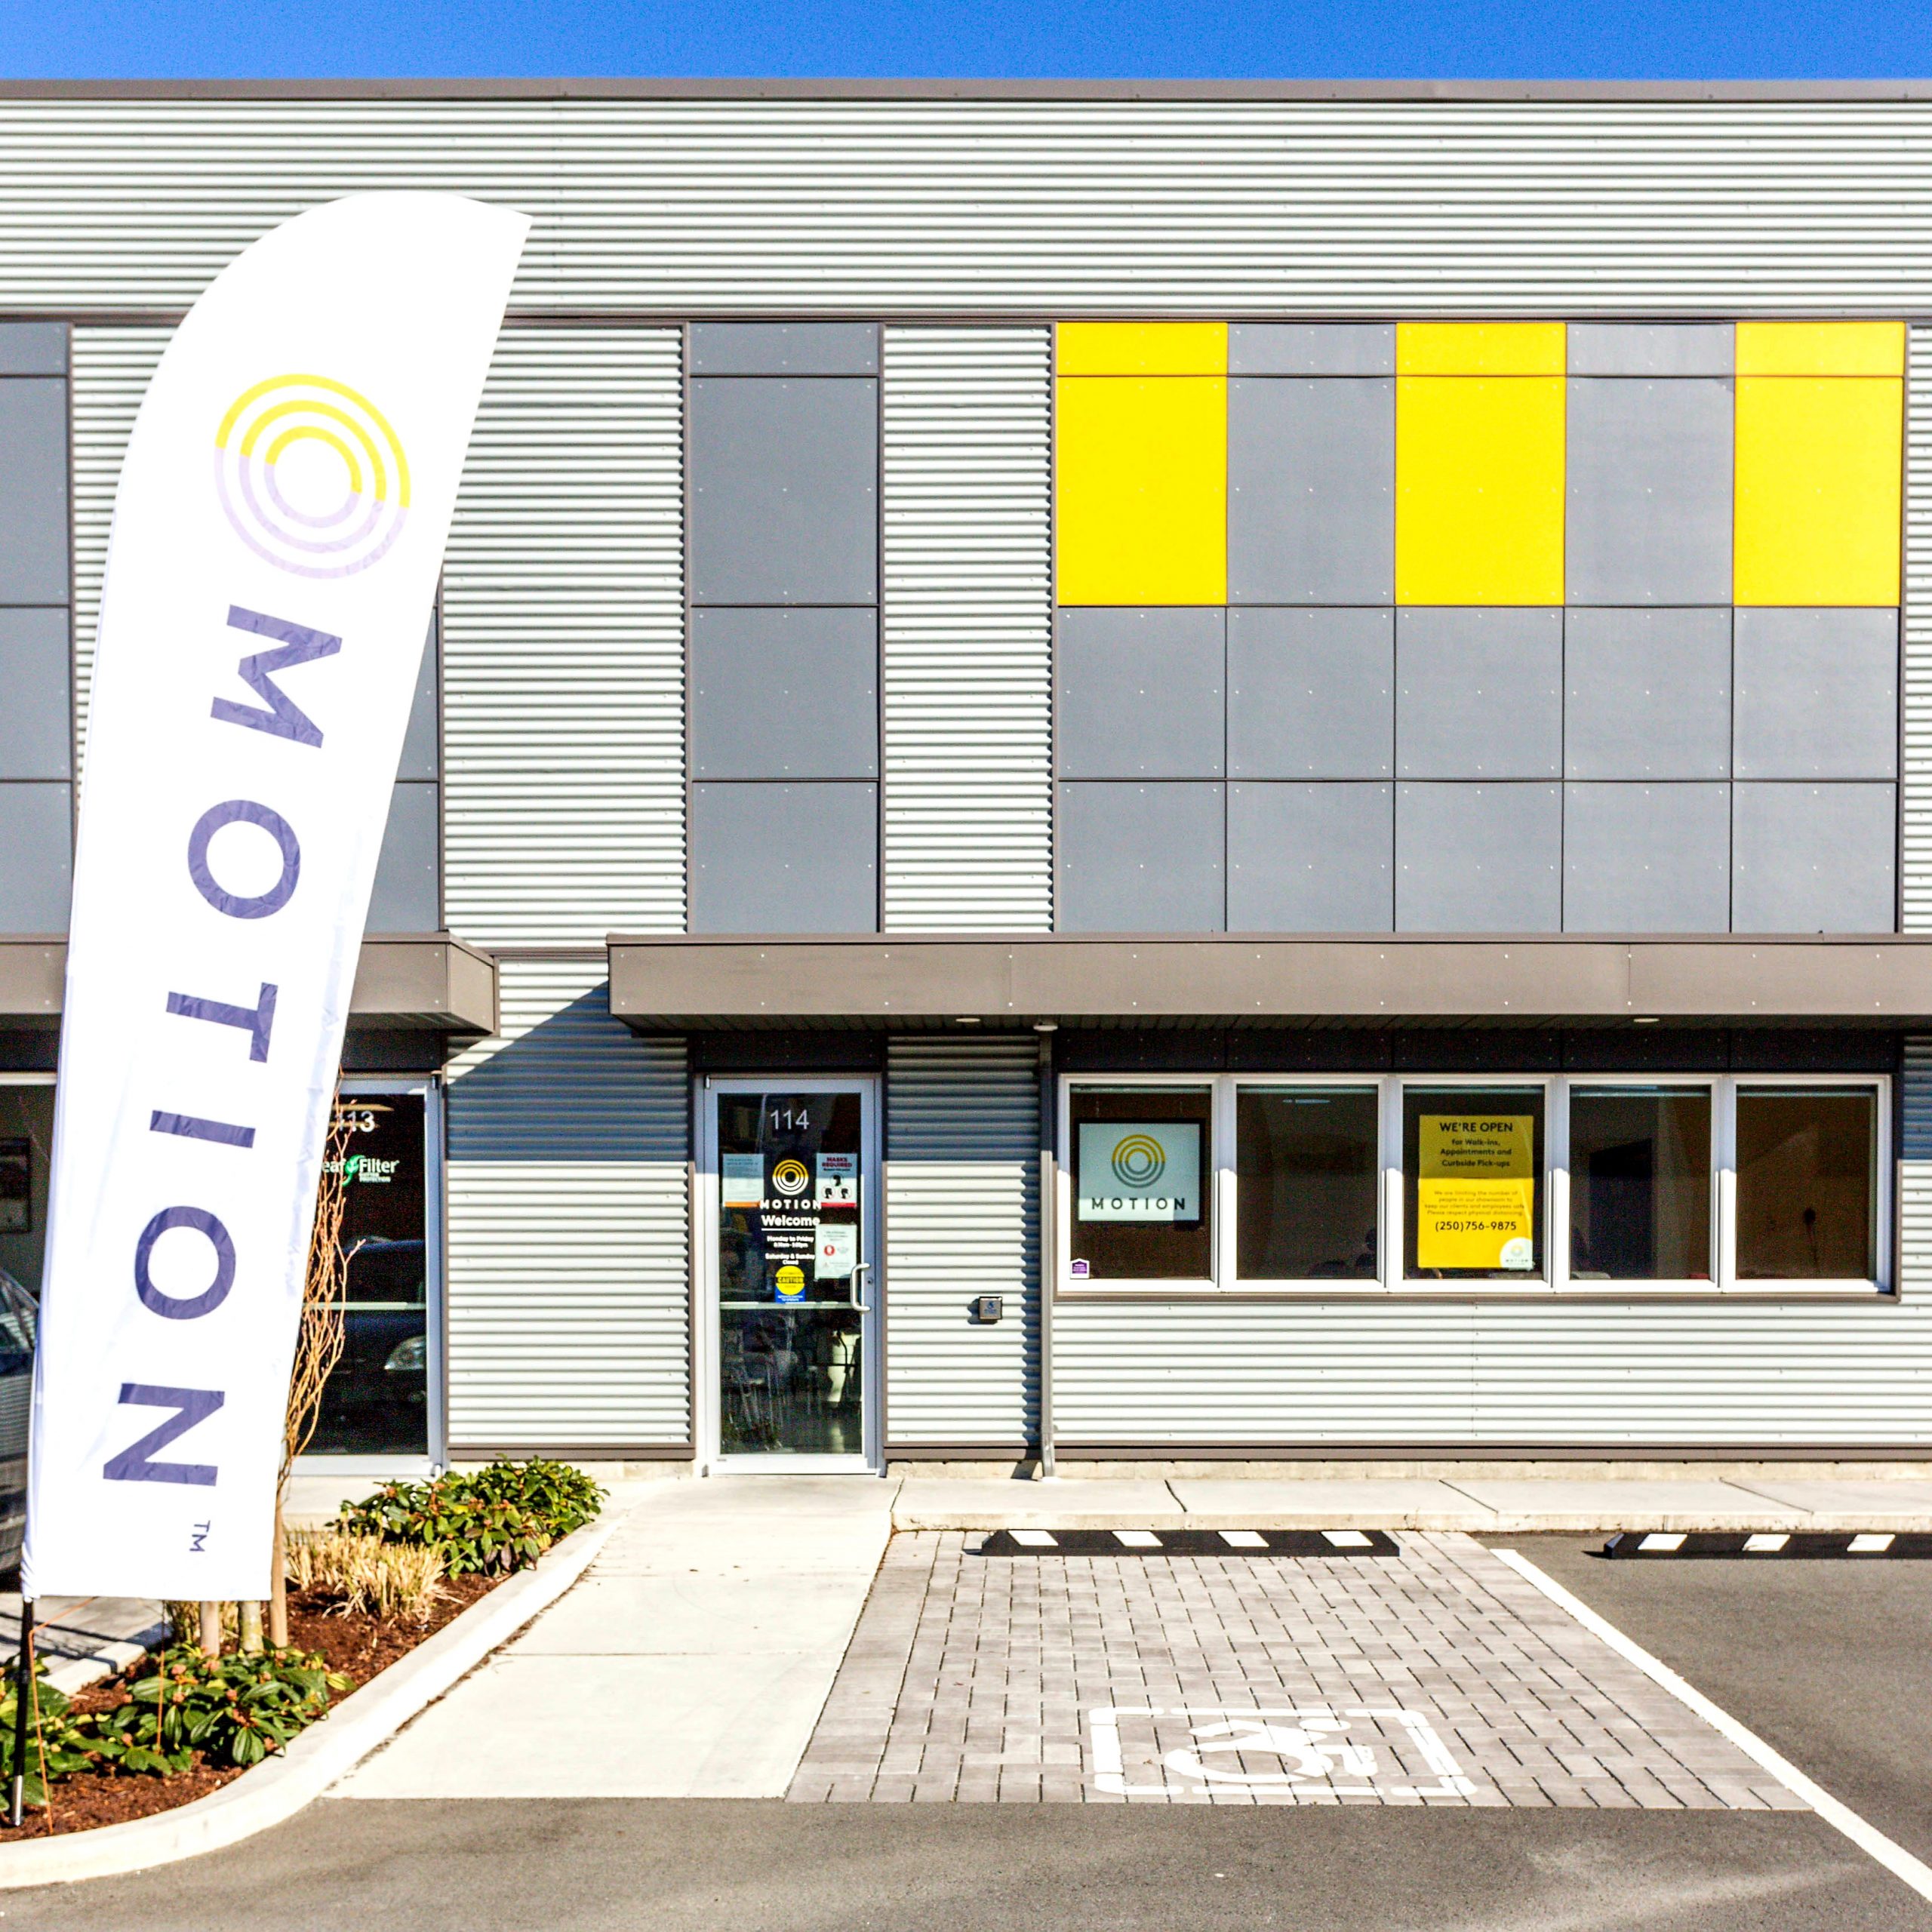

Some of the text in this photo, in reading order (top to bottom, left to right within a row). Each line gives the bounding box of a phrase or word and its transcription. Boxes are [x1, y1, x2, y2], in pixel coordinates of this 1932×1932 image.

[103, 605, 343, 1486] MOTION
[334, 1111, 375, 1132] 113
[771, 1109, 809, 1130] 114
[1439, 1122, 1513, 1132] WE'RE OPEN
[1465, 1138, 1500, 1146] Walk-ins,
[1440, 1148, 1494, 1157] Appointments
[359, 1158, 397, 1173] Filter
[1478, 1159, 1510, 1168] Pick-ups
[760, 1199, 821, 1211] MOTION
[1092, 1198, 1185, 1210] MOTION
[761, 1214, 820, 1226] Welcome
[1435, 1221, 1517, 1232] (250)756-9875
[189, 1520, 211, 1552] TM
